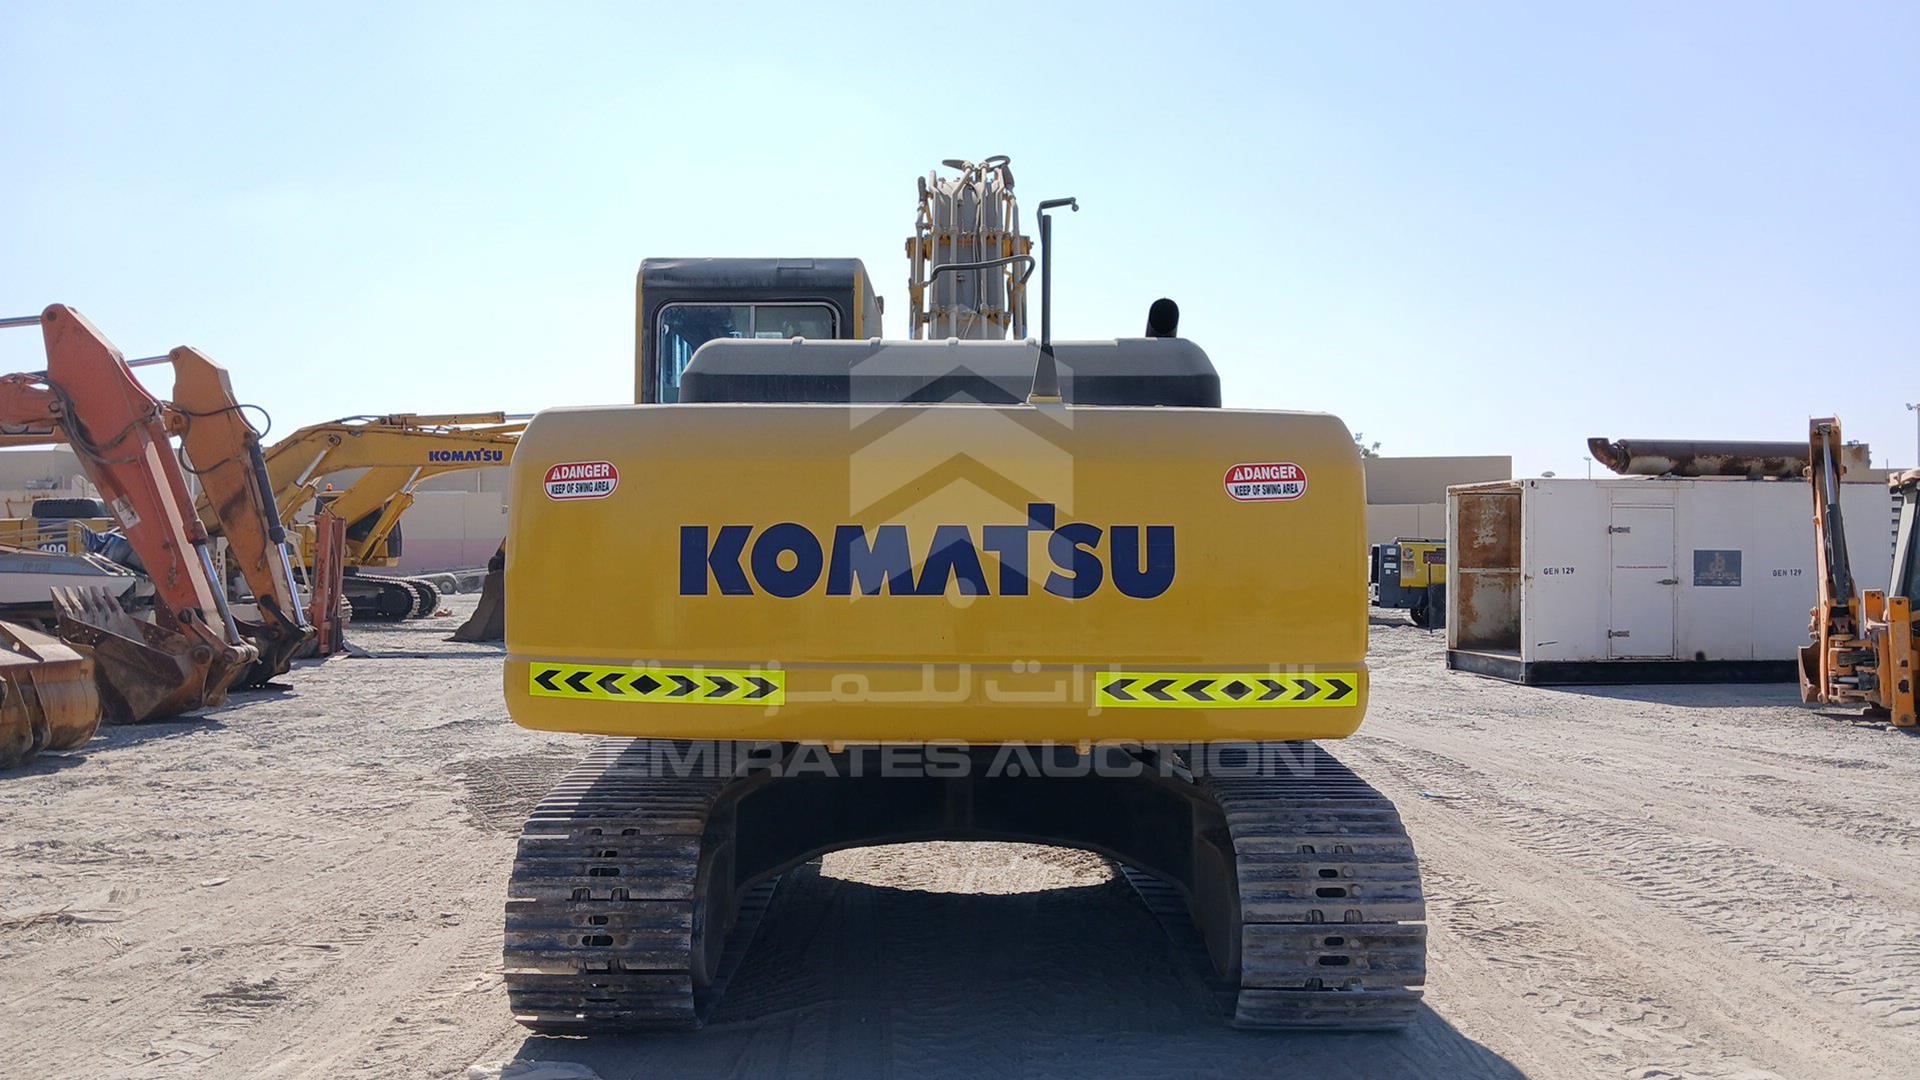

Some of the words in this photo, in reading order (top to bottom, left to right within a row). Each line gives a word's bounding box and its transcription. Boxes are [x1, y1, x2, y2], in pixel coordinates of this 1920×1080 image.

[429, 448, 502, 461] KOMATSU
[561, 464, 610, 479] DANGER
[1244, 466, 1297, 480] DANGER
[551, 484, 565, 494] KEEP
[567, 483, 575, 493] OF
[575, 482, 593, 493] SWING
[594, 481, 609, 492] AREA
[1234, 485, 1251, 496] KEEP
[1252, 485, 1261, 495] OF
[1262, 484, 1281, 495] SWING
[1283, 483, 1299, 494] AREA
[680, 503, 1176, 599] KOMATSU
[1562, 567, 1575, 575] 129
